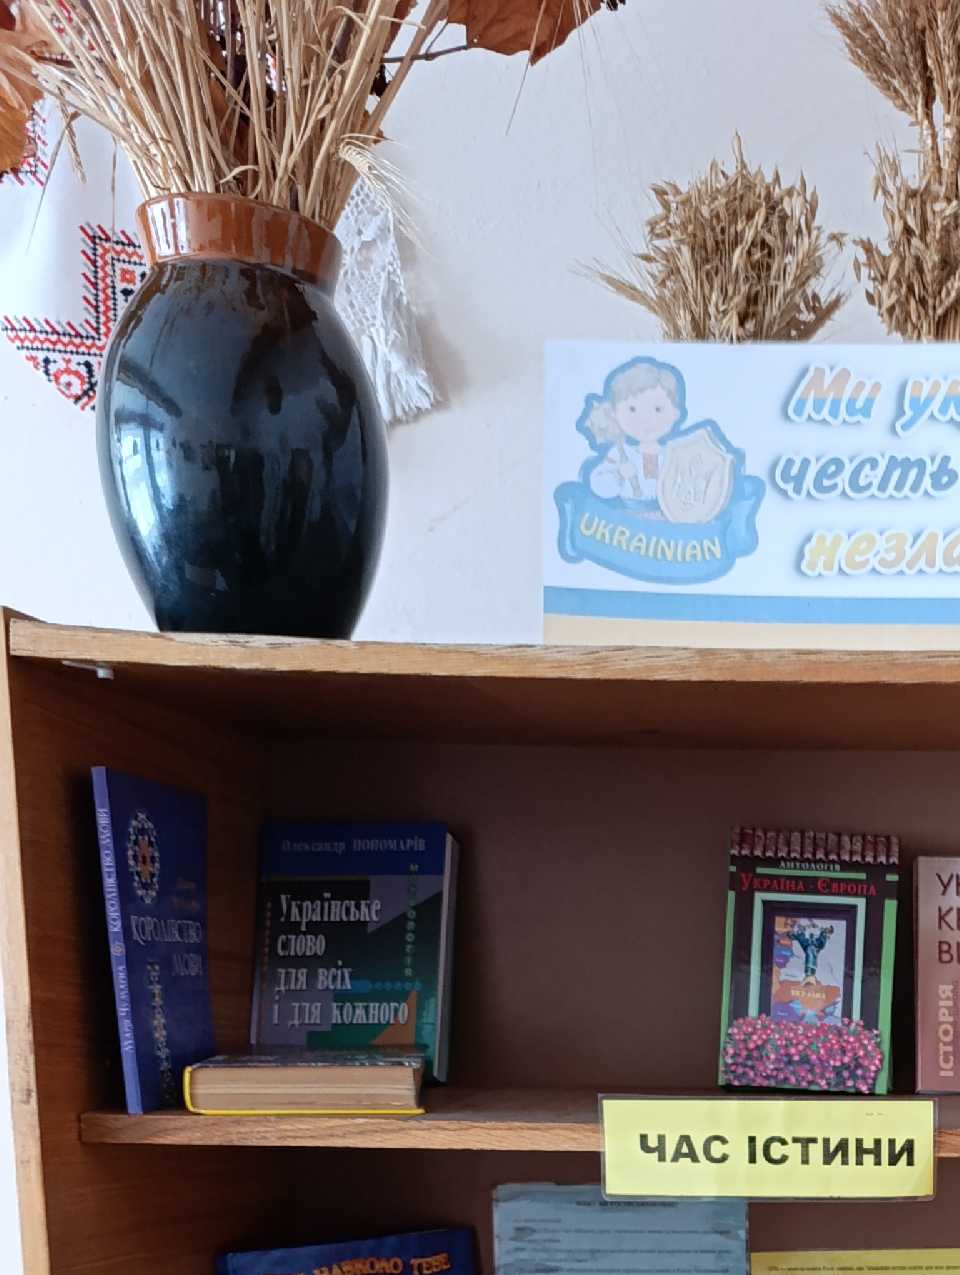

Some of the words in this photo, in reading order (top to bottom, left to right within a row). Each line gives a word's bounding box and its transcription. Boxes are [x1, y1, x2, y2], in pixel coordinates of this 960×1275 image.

[786, 362, 886, 423] Ми
[775, 449, 960, 497] честь
[578, 511, 723, 562] UKRAINIAN
[280, 893, 381, 931] Українське
[277, 934, 326, 957] слово
[275, 968, 307, 992] для
[318, 960, 353, 991] всіх
[272, 995, 280, 1025] і
[288, 1002, 321, 1028] для
[331, 1002, 409, 1025] кожного
[938, 984, 954, 1078] ІСТОРІЯ
[639, 1133, 730, 1165] ЧАС
[748, 1134, 916, 1168] ІСТИНИ
